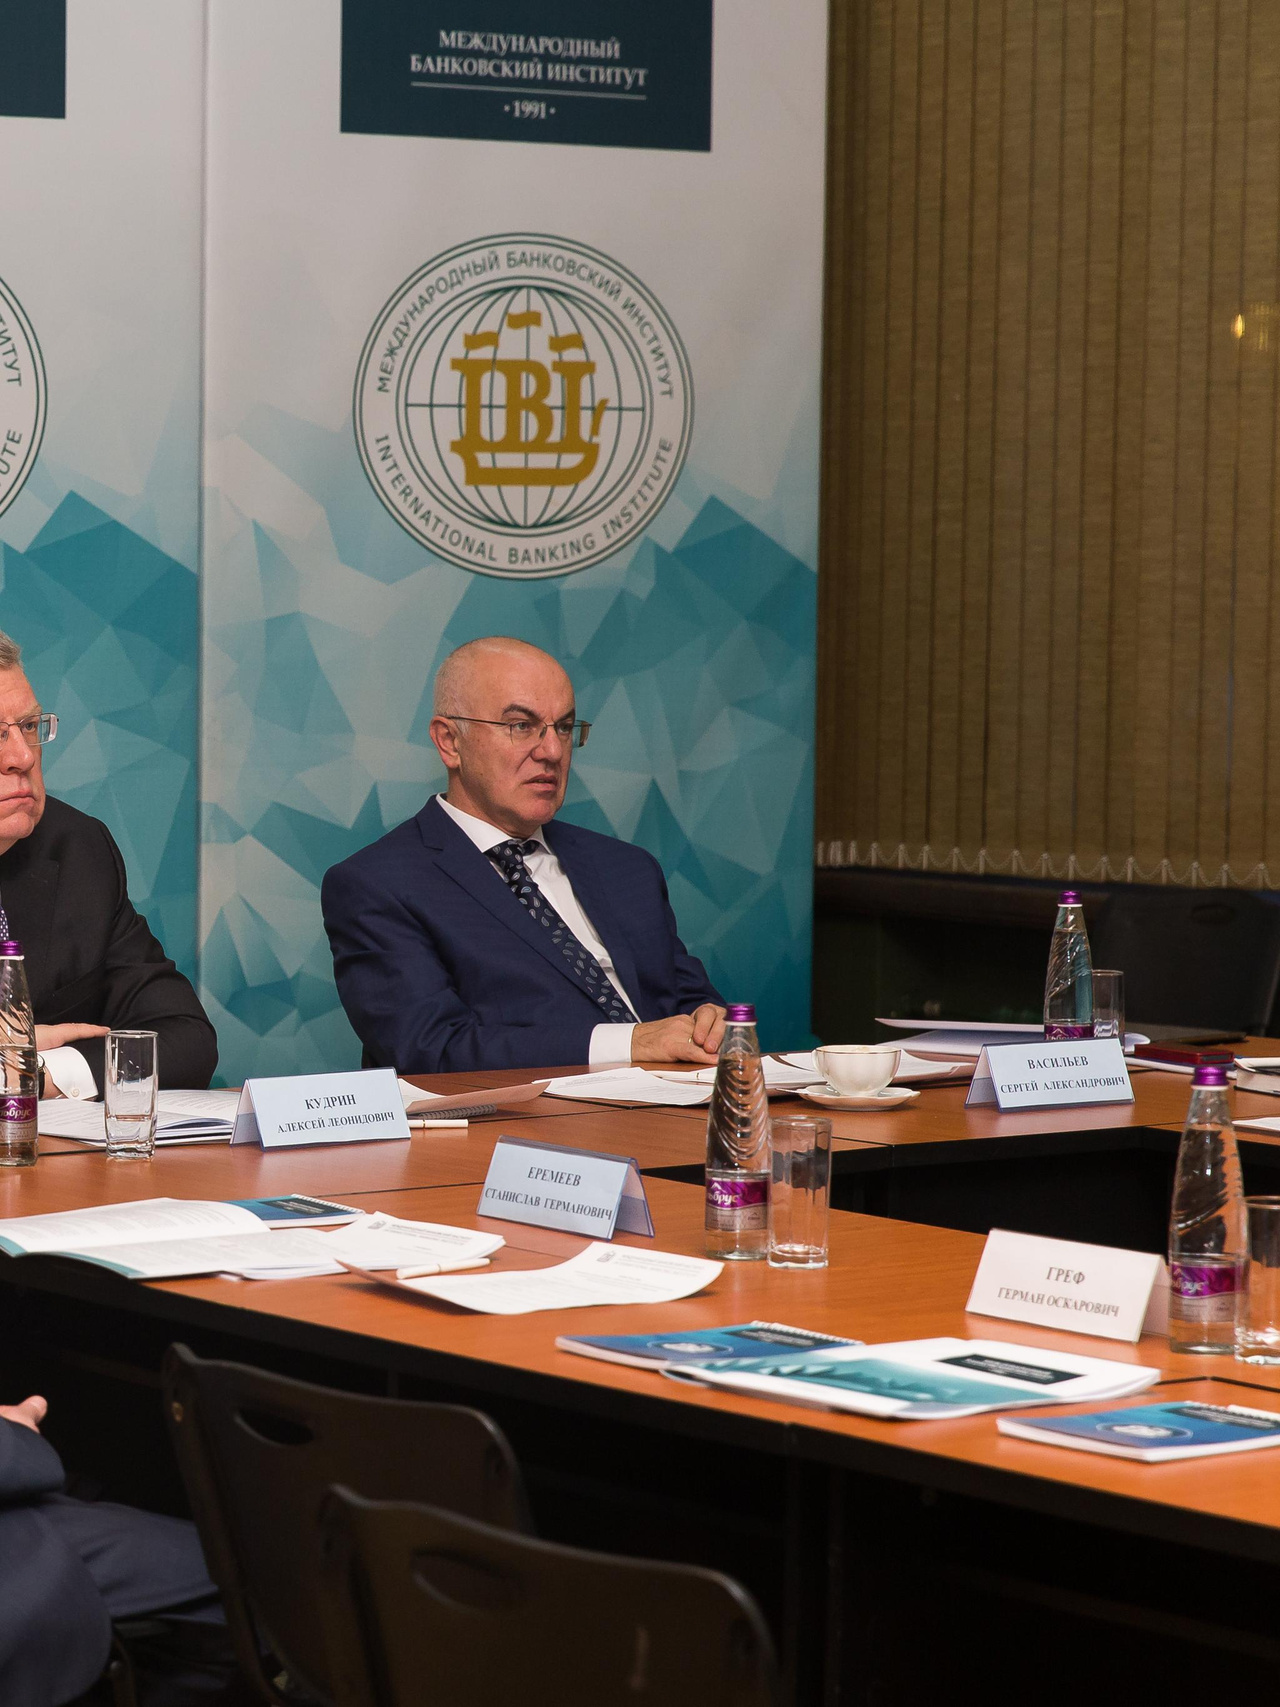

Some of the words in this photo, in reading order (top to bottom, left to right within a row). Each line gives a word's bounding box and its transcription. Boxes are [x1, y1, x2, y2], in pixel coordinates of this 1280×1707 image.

[439, 29, 620, 60] МЕЖДУНАРОДНЫЙ
[410, 54, 542, 80] БАНКОВСКИЙ
[547, 64, 648, 90] ИНСТИТУТ
[377, 250, 500, 393] МЕЖДУНАРОДНЫЙ
[506, 250, 623, 302] БАНКОВСКИЙ
[621, 296, 674, 397] ИНСТИТУТ
[375, 434, 497, 562] INTERNATIONAL
[507, 533, 597, 565] BANKING
[603, 436, 673, 539] INSTITUTE
[1027, 1055, 1089, 1070] ВАСИЛЬЕВ
[1000, 1080, 1039, 1094] СЕРГЕЙ
[1043, 1076, 1125, 1091] АЛЕКСАНДРОВИЧ
[305, 1094, 356, 1110] КУДРИН
[277, 1117, 326, 1134] АЛЕКСЕЙ
[327, 1111, 395, 1128] ЛЕОНИДОВИЧ
[527, 1166, 582, 1187] ЕРЕМЕЕВ
[484, 1187, 541, 1207] СТАНИСЛАВ
[543, 1198, 613, 1221] ГЕРМАНОВИЧ
[1046, 1266, 1085, 1285] ГРЕФ
[997, 1287, 1046, 1305] ГЕРМАН
[1046, 1294, 1120, 1318] ОСКАРОВИЧ
